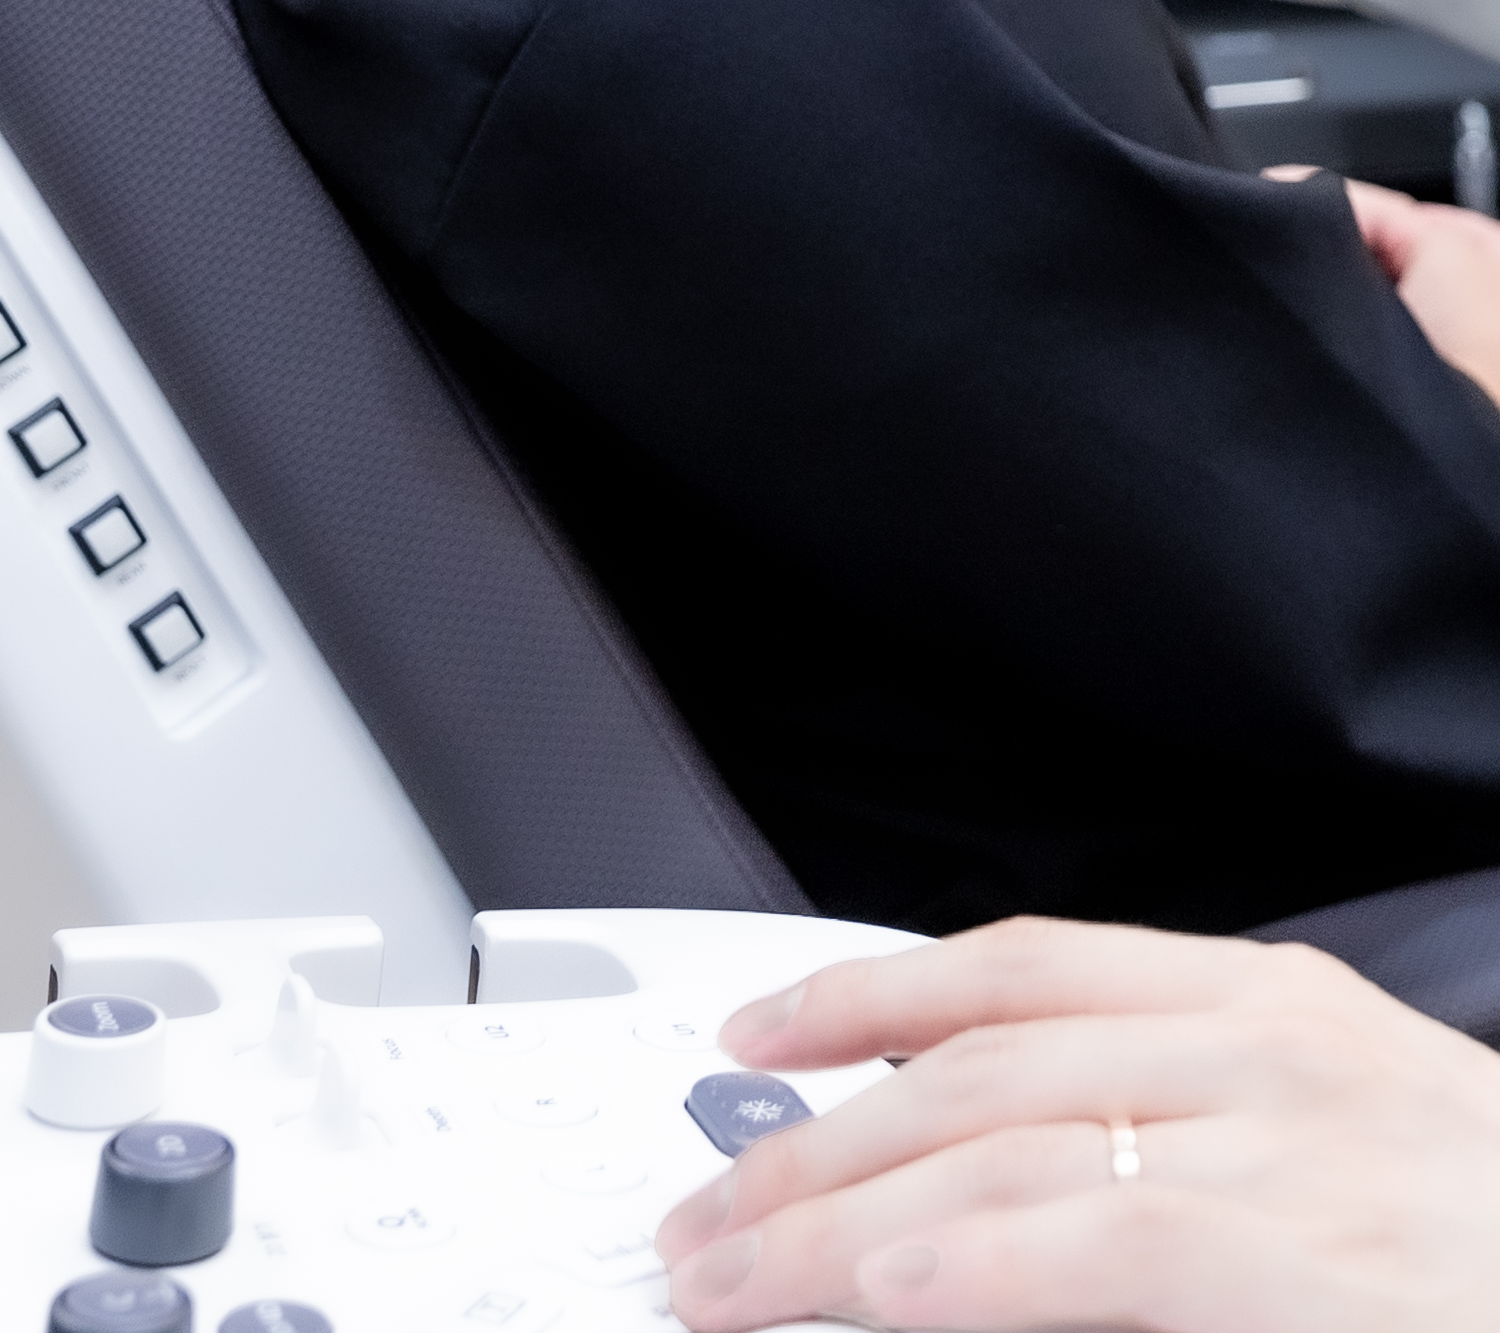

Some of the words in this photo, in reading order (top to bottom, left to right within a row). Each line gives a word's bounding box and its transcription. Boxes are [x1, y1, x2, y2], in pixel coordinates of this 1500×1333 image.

[92, 1001, 119, 1031] Zoom
[484, 1023, 510, 1040] U2
[671, 1022, 696, 1037] U1
